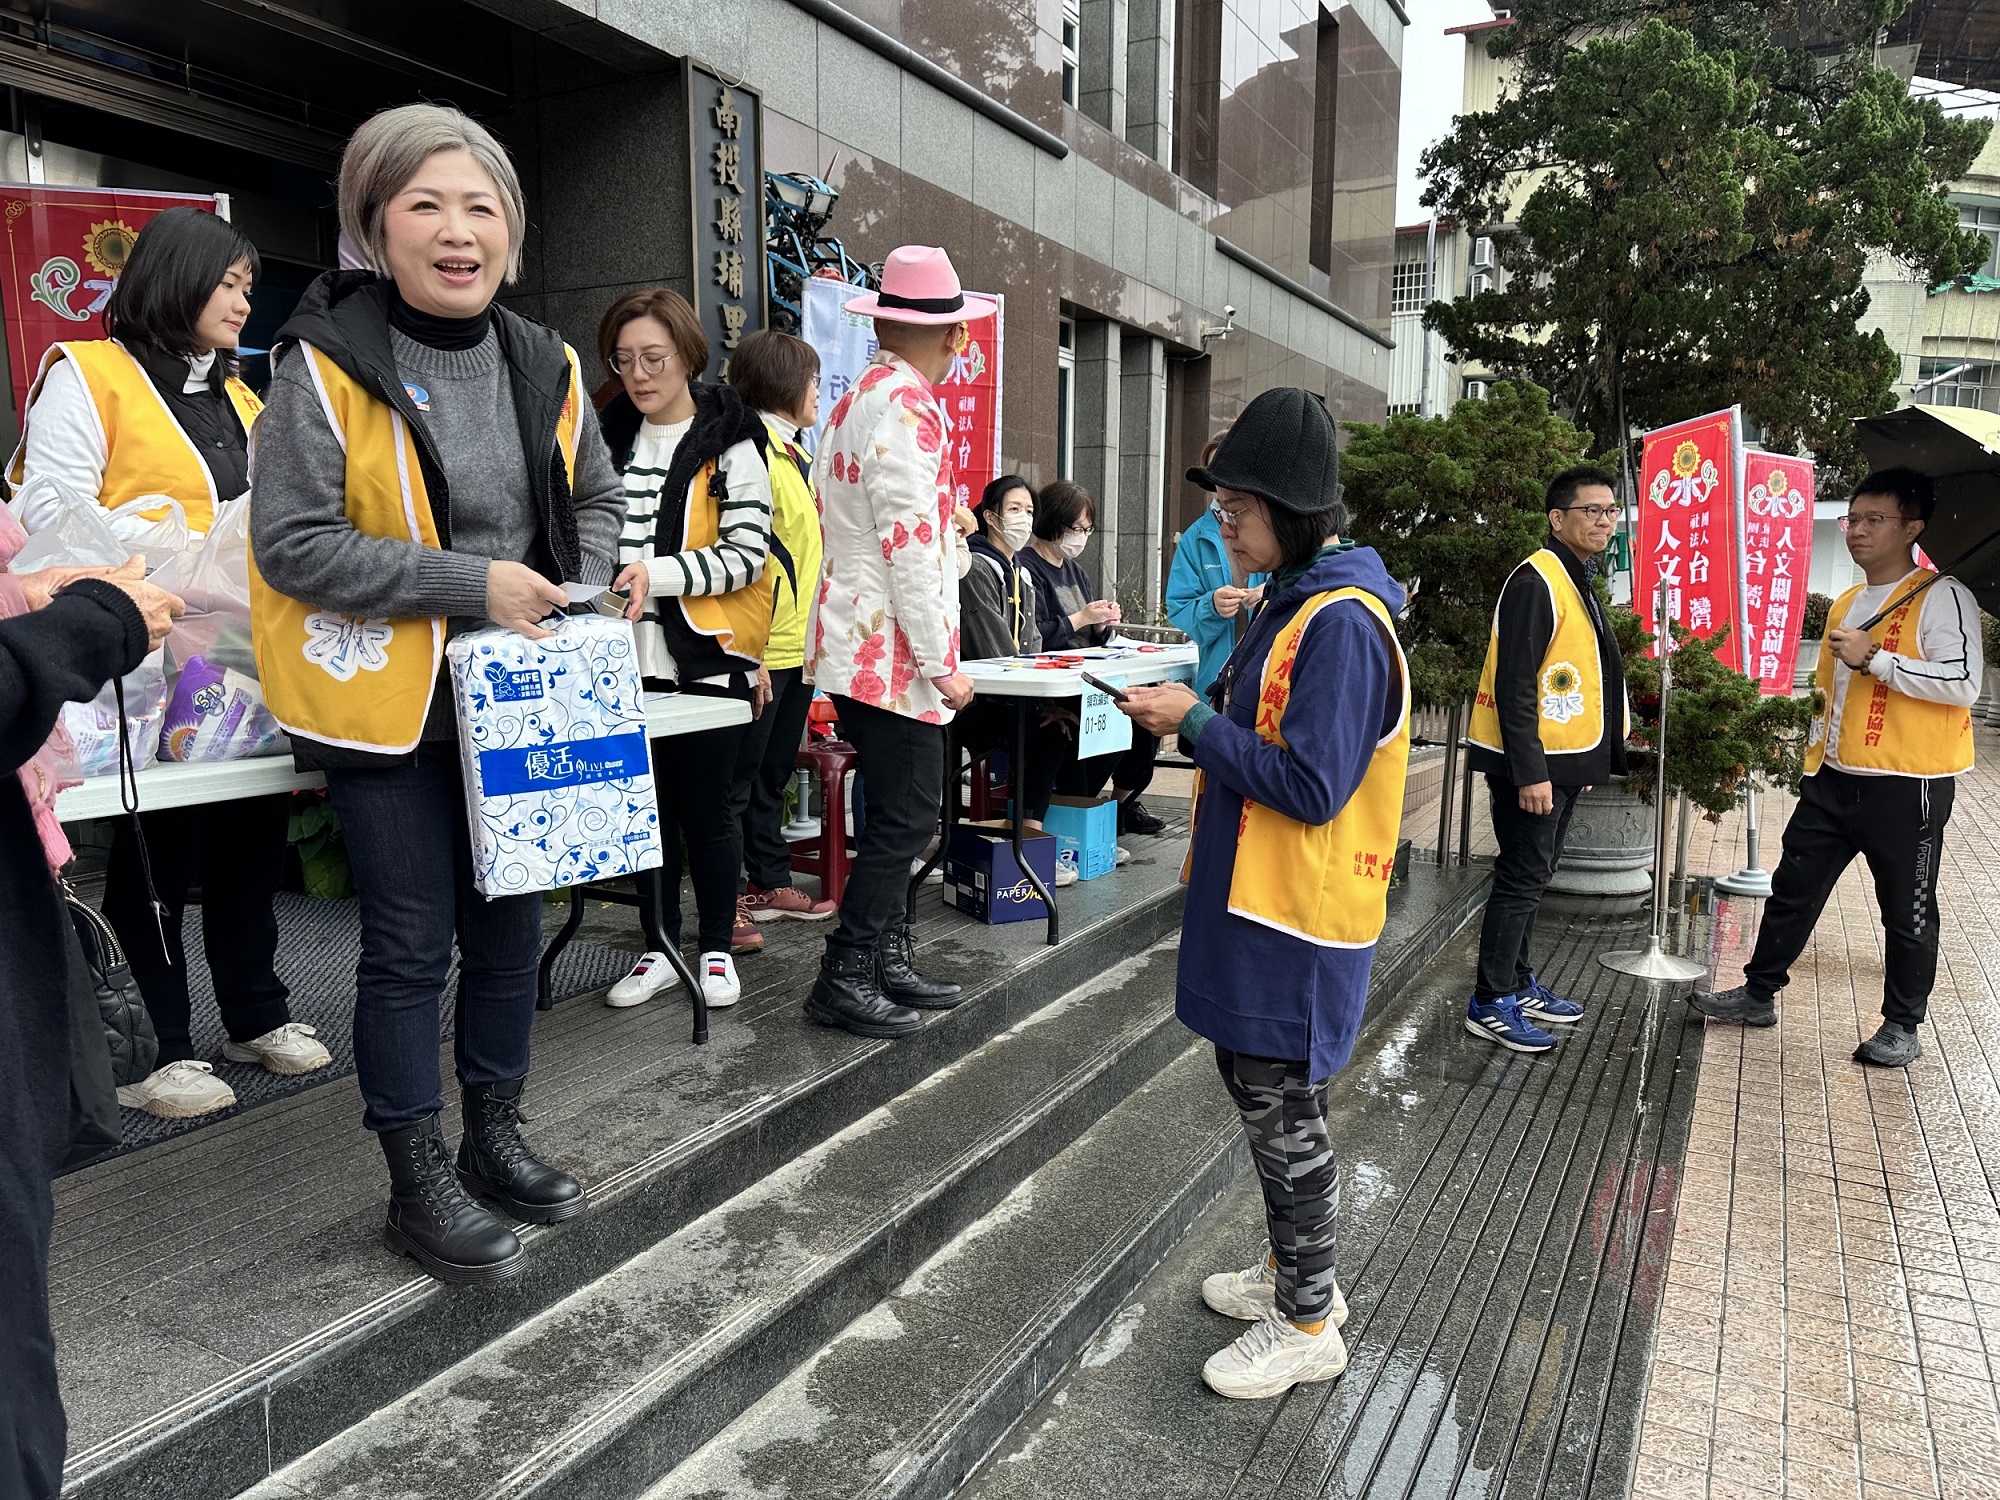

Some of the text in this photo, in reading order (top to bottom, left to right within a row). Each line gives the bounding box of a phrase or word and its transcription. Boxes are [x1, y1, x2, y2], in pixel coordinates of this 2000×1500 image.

[714, 86, 748, 385] 南投縣埔里
[511, 671, 541, 685] SAFE
[1085, 713, 1107, 735] 01-68
[524, 745, 574, 780] 優活
